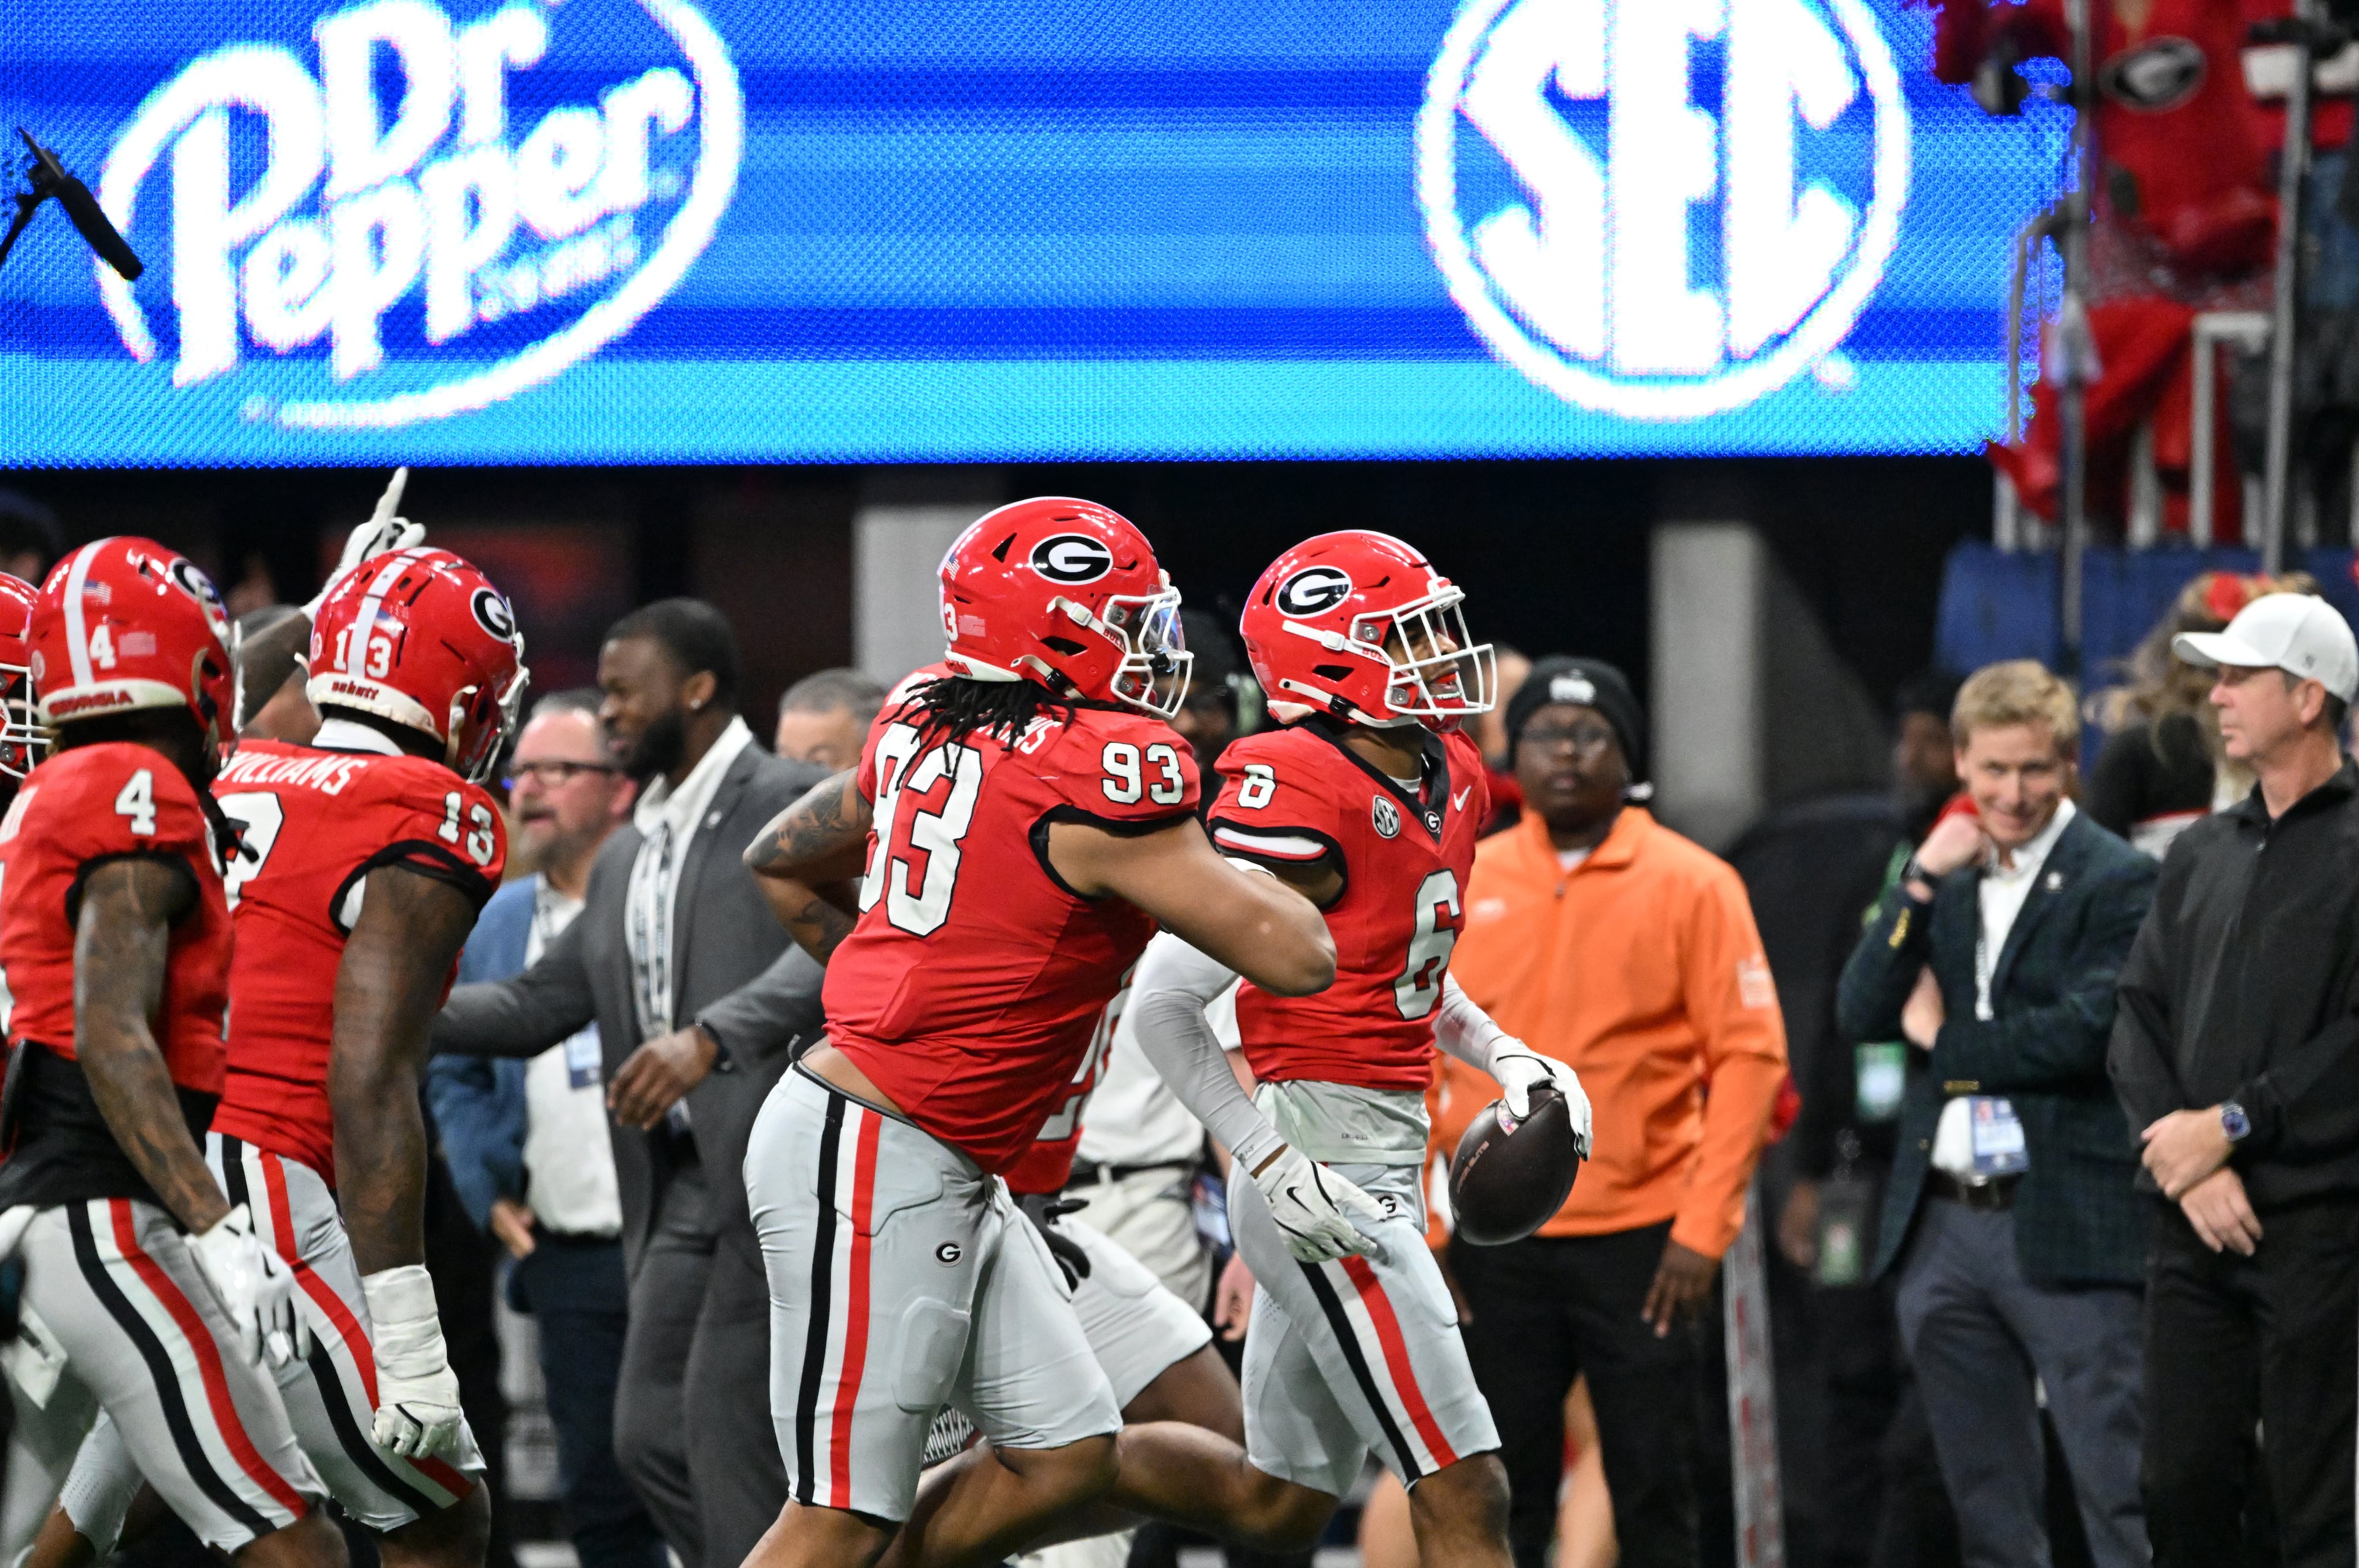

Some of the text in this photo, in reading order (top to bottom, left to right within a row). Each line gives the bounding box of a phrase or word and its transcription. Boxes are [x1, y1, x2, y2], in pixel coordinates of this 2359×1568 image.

[312, 0, 548, 201] Dr
[100, 41, 694, 388] Pepper
[1461, 0, 1861, 376] SEC
[1031, 535, 1111, 582] G
[473, 590, 512, 639] G
[1278, 568, 1350, 615] G
[90, 625, 117, 669] 4
[217, 750, 369, 796] WILLIAMS
[1101, 741, 1184, 805] 93
[115, 768, 157, 837] 4
[437, 790, 495, 867] 13
[858, 720, 983, 939] 93
[1375, 797, 1399, 836] SEC
[1425, 812, 1441, 832] G
[1394, 867, 1461, 1021] 6
[935, 1242, 961, 1263] G
